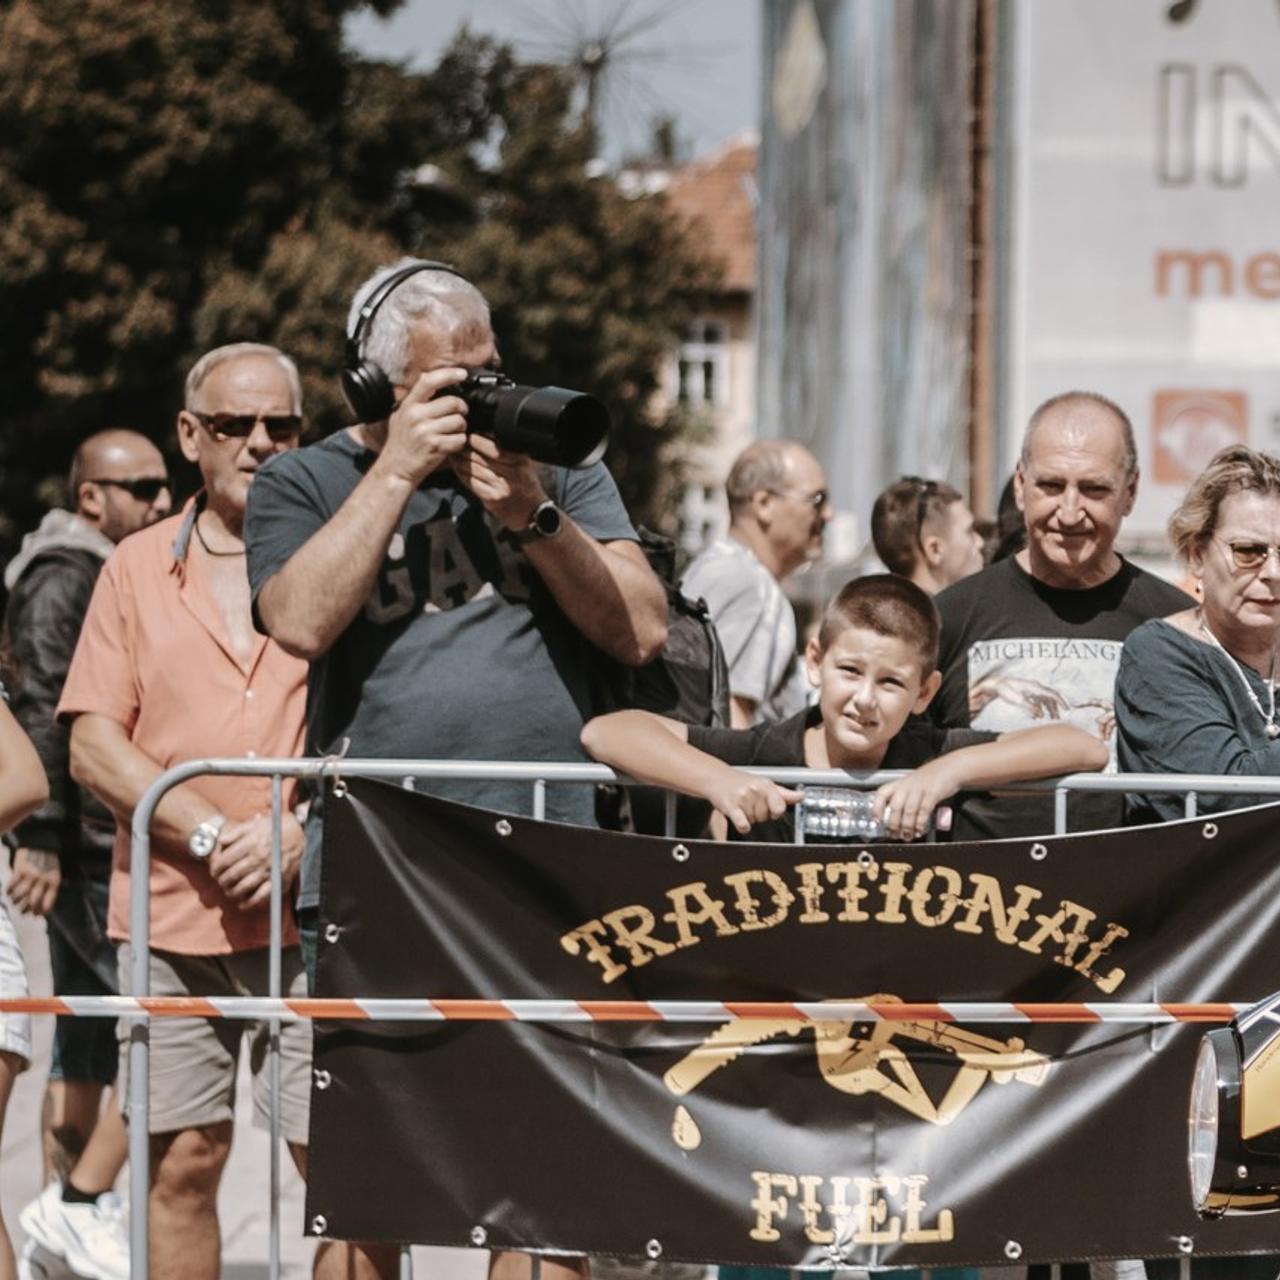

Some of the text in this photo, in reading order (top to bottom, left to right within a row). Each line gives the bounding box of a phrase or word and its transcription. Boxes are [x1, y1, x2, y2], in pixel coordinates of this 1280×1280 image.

[972, 641, 1117, 664] MICHELANG
[560, 861, 1130, 994] TRADITIONAL
[749, 1170, 954, 1244] FUEL
